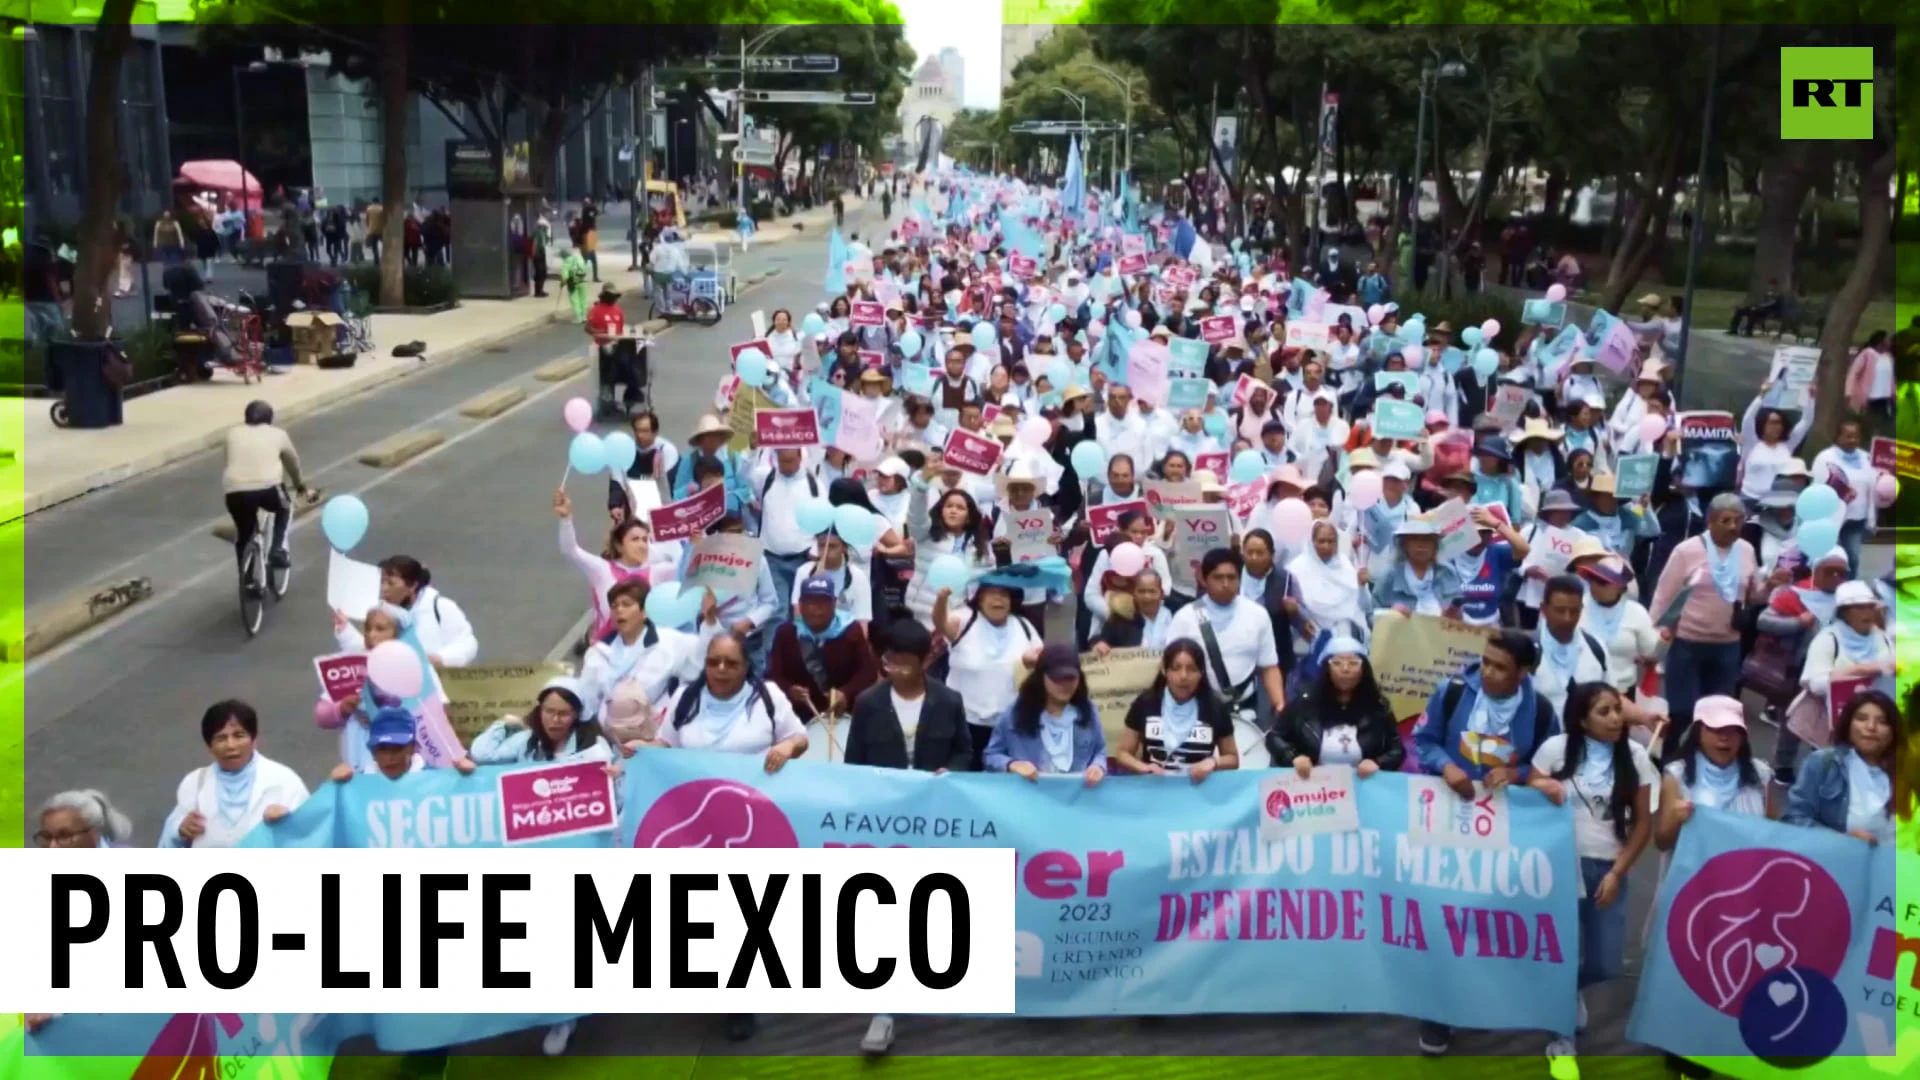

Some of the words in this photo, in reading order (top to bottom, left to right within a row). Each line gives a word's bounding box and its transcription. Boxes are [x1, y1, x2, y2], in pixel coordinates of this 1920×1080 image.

[1185, 518, 1217, 533] YO
[1293, 787, 1347, 804] mujer
[512, 801, 606, 830] México
[1296, 806, 1336, 819] vida
[1475, 793, 1496, 837] YO
[820, 812, 836, 831] A
[845, 813, 927, 836] FAVOR
[934, 818, 962, 838] DE
[970, 820, 998, 839] LA
[1167, 831, 1316, 881] ESTADO
[1332, 829, 1382, 877] DE
[1059, 904, 1112, 922] 2023
[1156, 889, 1365, 943] DEFIENDE
[1381, 894, 1429, 952] LA
[1443, 904, 1564, 964] VIDA
[1055, 929, 1141, 946] SEGUIMOS
[1052, 946, 1144, 964] CREYENDO
[1051, 967, 1073, 985] EN
